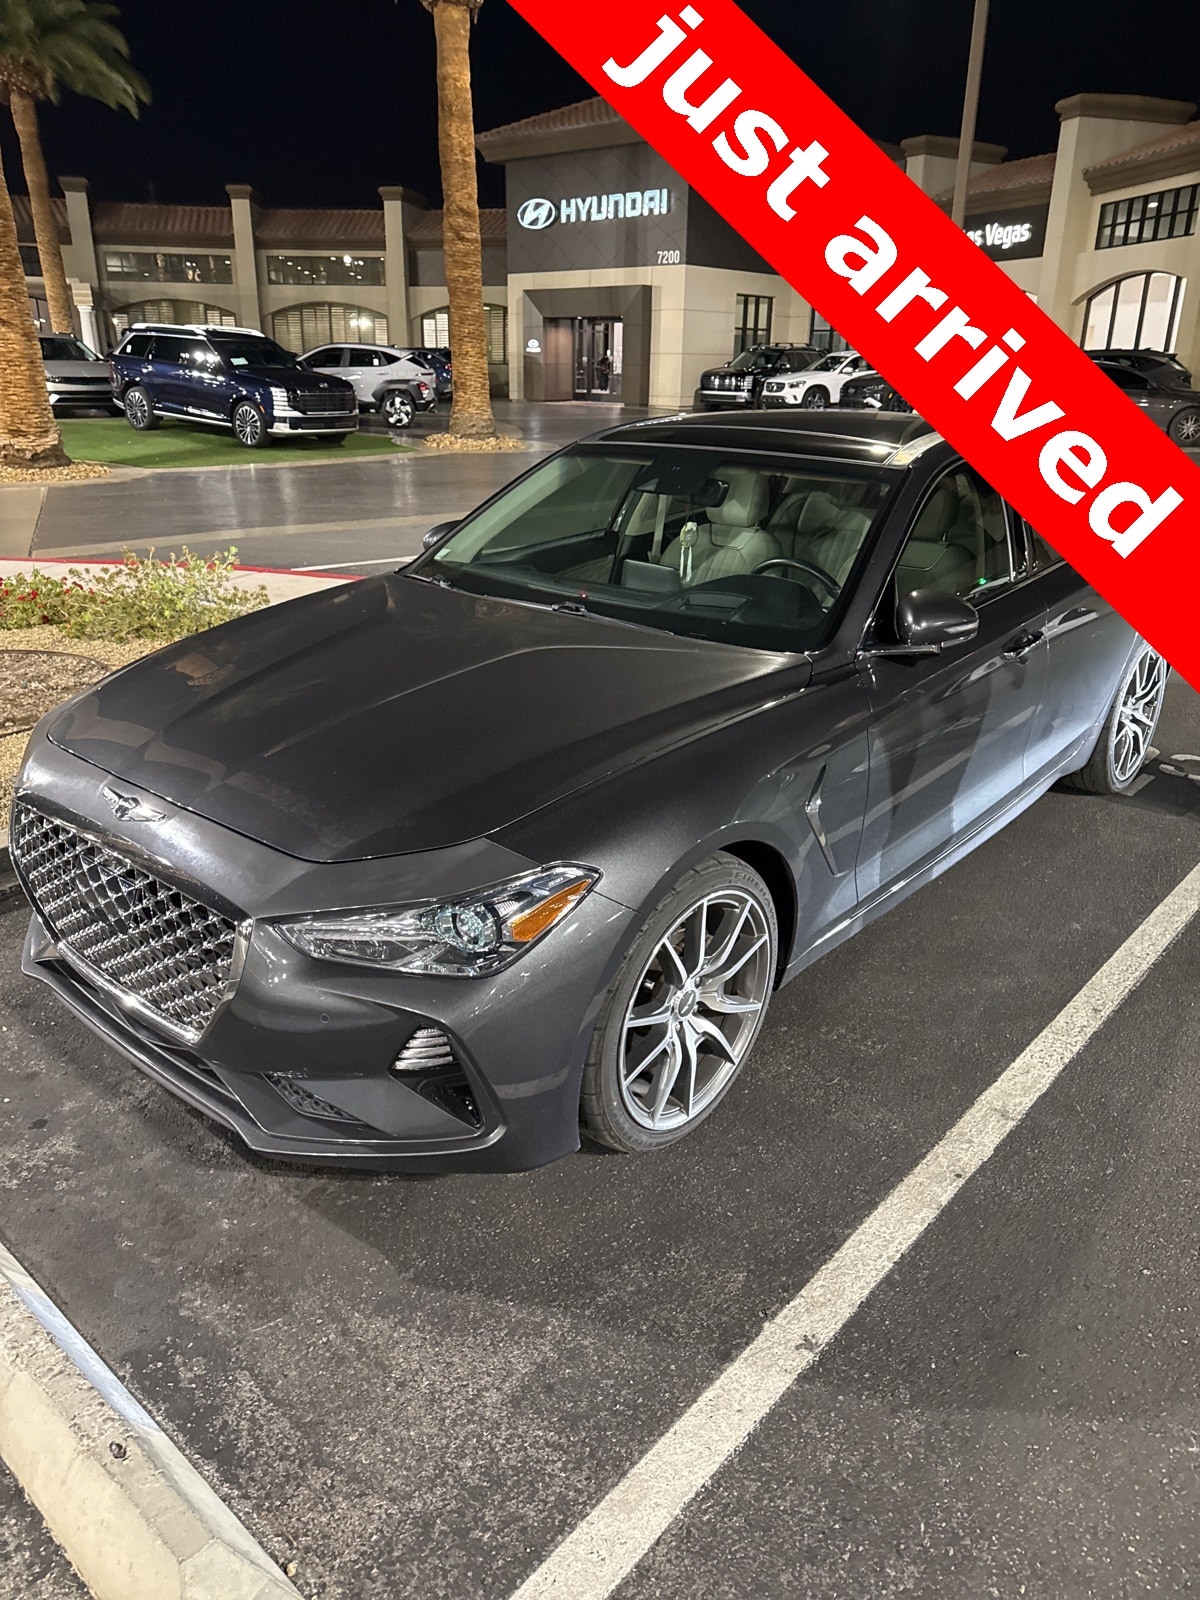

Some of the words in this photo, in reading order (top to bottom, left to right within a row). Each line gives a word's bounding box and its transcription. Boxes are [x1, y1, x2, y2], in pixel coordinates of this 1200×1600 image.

[560, 188, 669, 224] HYUNDAI
[985, 222, 1032, 249] Vegas
[656, 250, 680, 265] 7200
